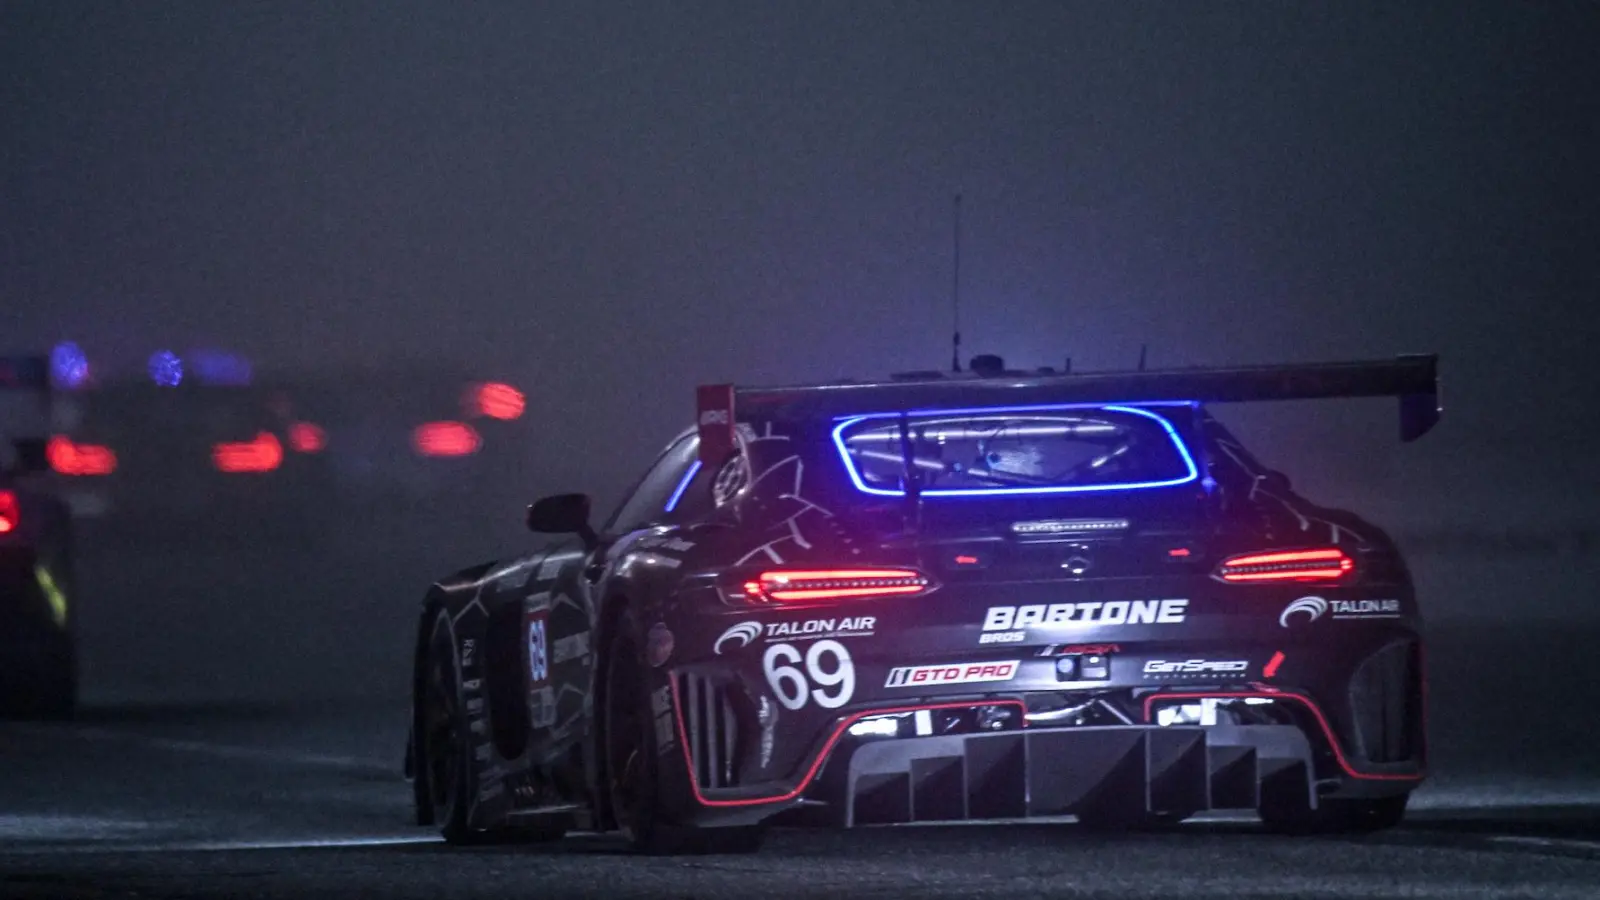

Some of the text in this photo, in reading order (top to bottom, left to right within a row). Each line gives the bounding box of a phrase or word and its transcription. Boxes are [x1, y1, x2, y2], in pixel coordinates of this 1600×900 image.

[982, 599, 1189, 630] BARTONE
[1330, 600, 1378, 612] TALON
[765, 616, 877, 636] TALON AIR
[978, 631, 1025, 644] BROS
[762, 639, 856, 710] 69
[911, 664, 1013, 682] GTD PRO
